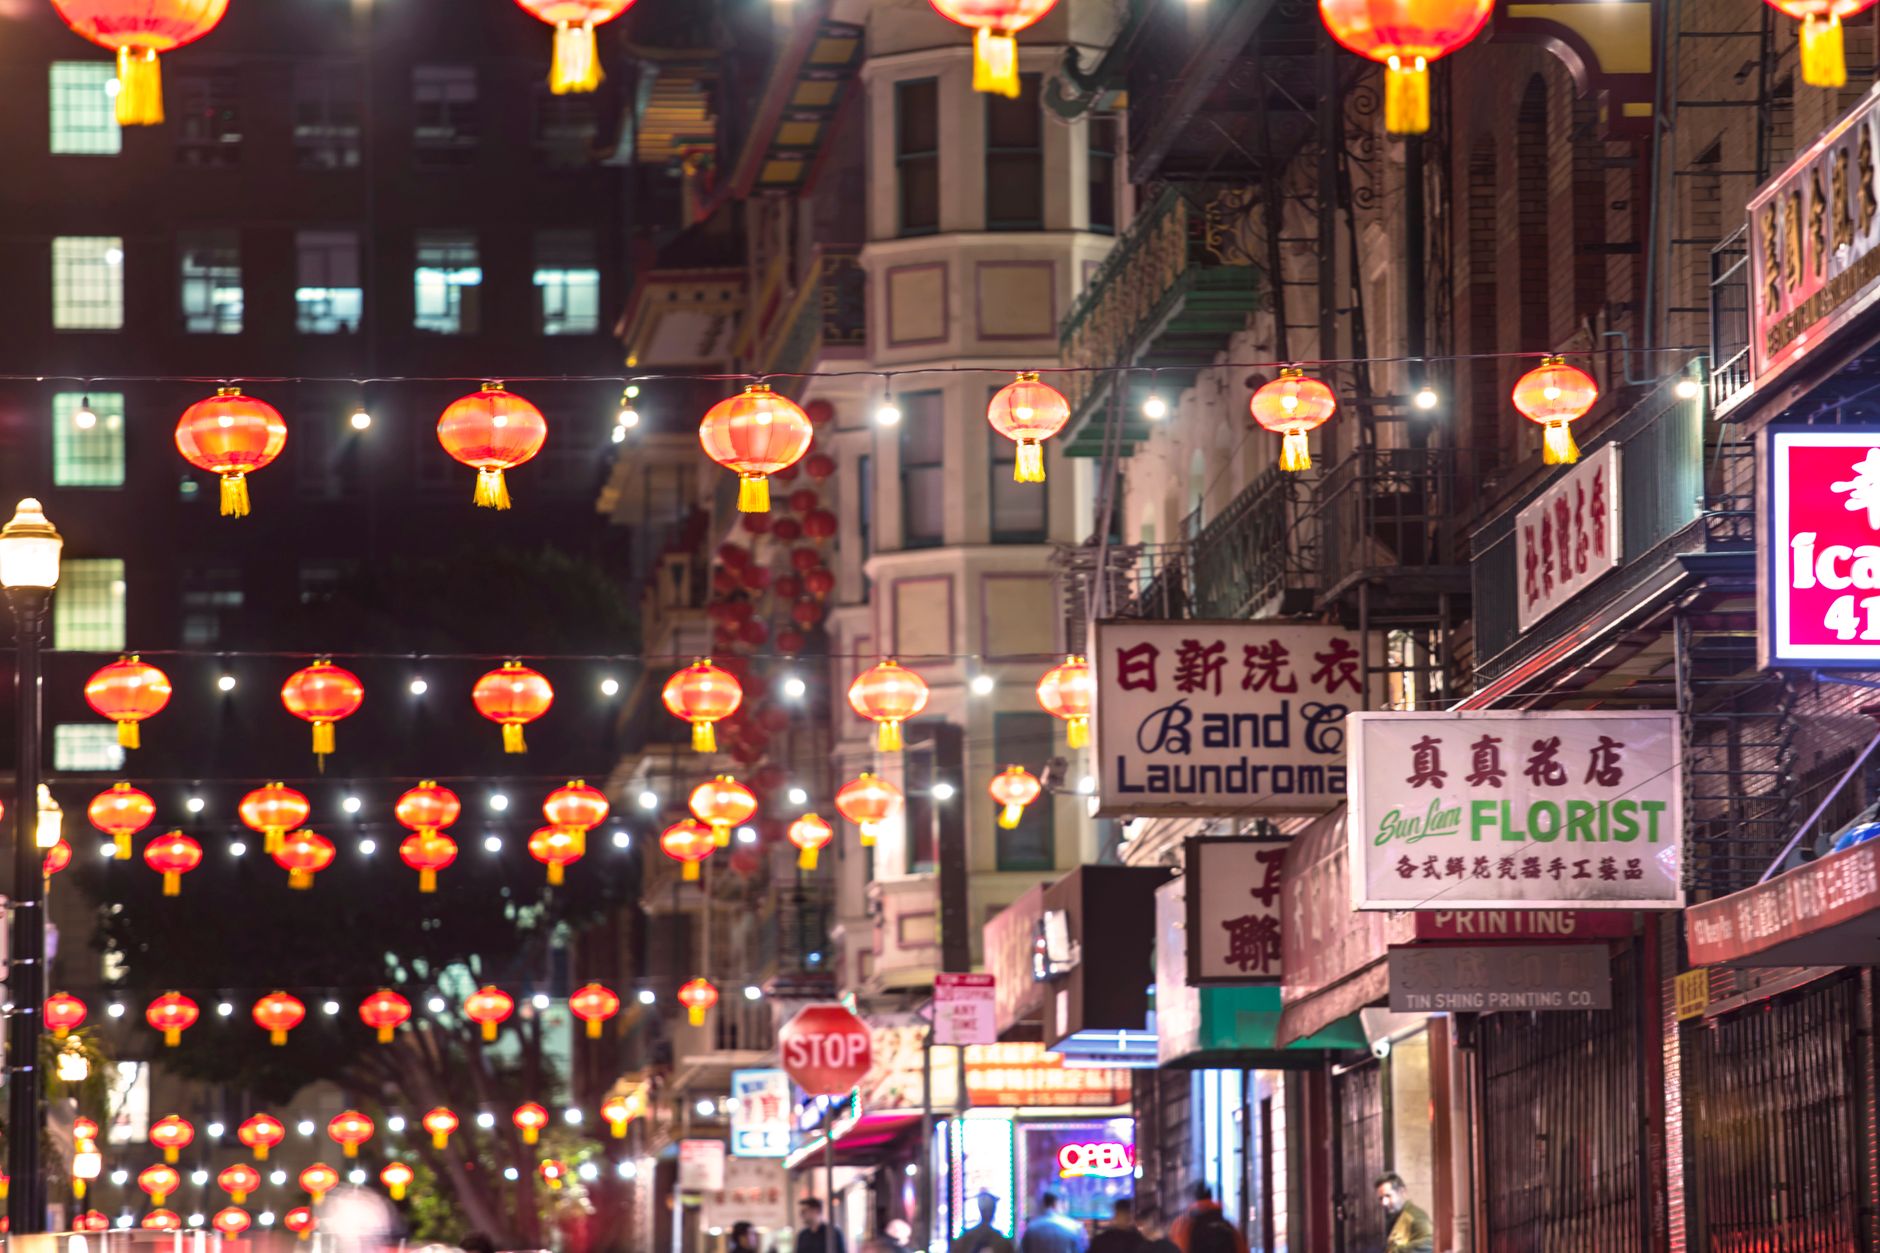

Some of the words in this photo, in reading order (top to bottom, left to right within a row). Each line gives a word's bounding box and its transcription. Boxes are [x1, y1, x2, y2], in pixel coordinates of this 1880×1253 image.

[1117, 638, 1367, 696] 日新洗衣
[1137, 698, 1192, 755] B
[1203, 700, 1289, 748] and
[1406, 734, 1626, 789] 真真花店
[1374, 809, 1420, 846] Sun
[1406, 797, 1462, 844] Lam
[1471, 799, 1665, 842] FLORIST
[1435, 911, 1576, 934] PRINTING
[1407, 994, 1431, 1008] TIN
[1435, 993, 1484, 1008] SHING
[1489, 992, 1562, 1007] PRINTING
[1568, 991, 1596, 1006] CO.
[787, 1033, 867, 1068] STOP
[1057, 1142, 1135, 1172] OPEN
